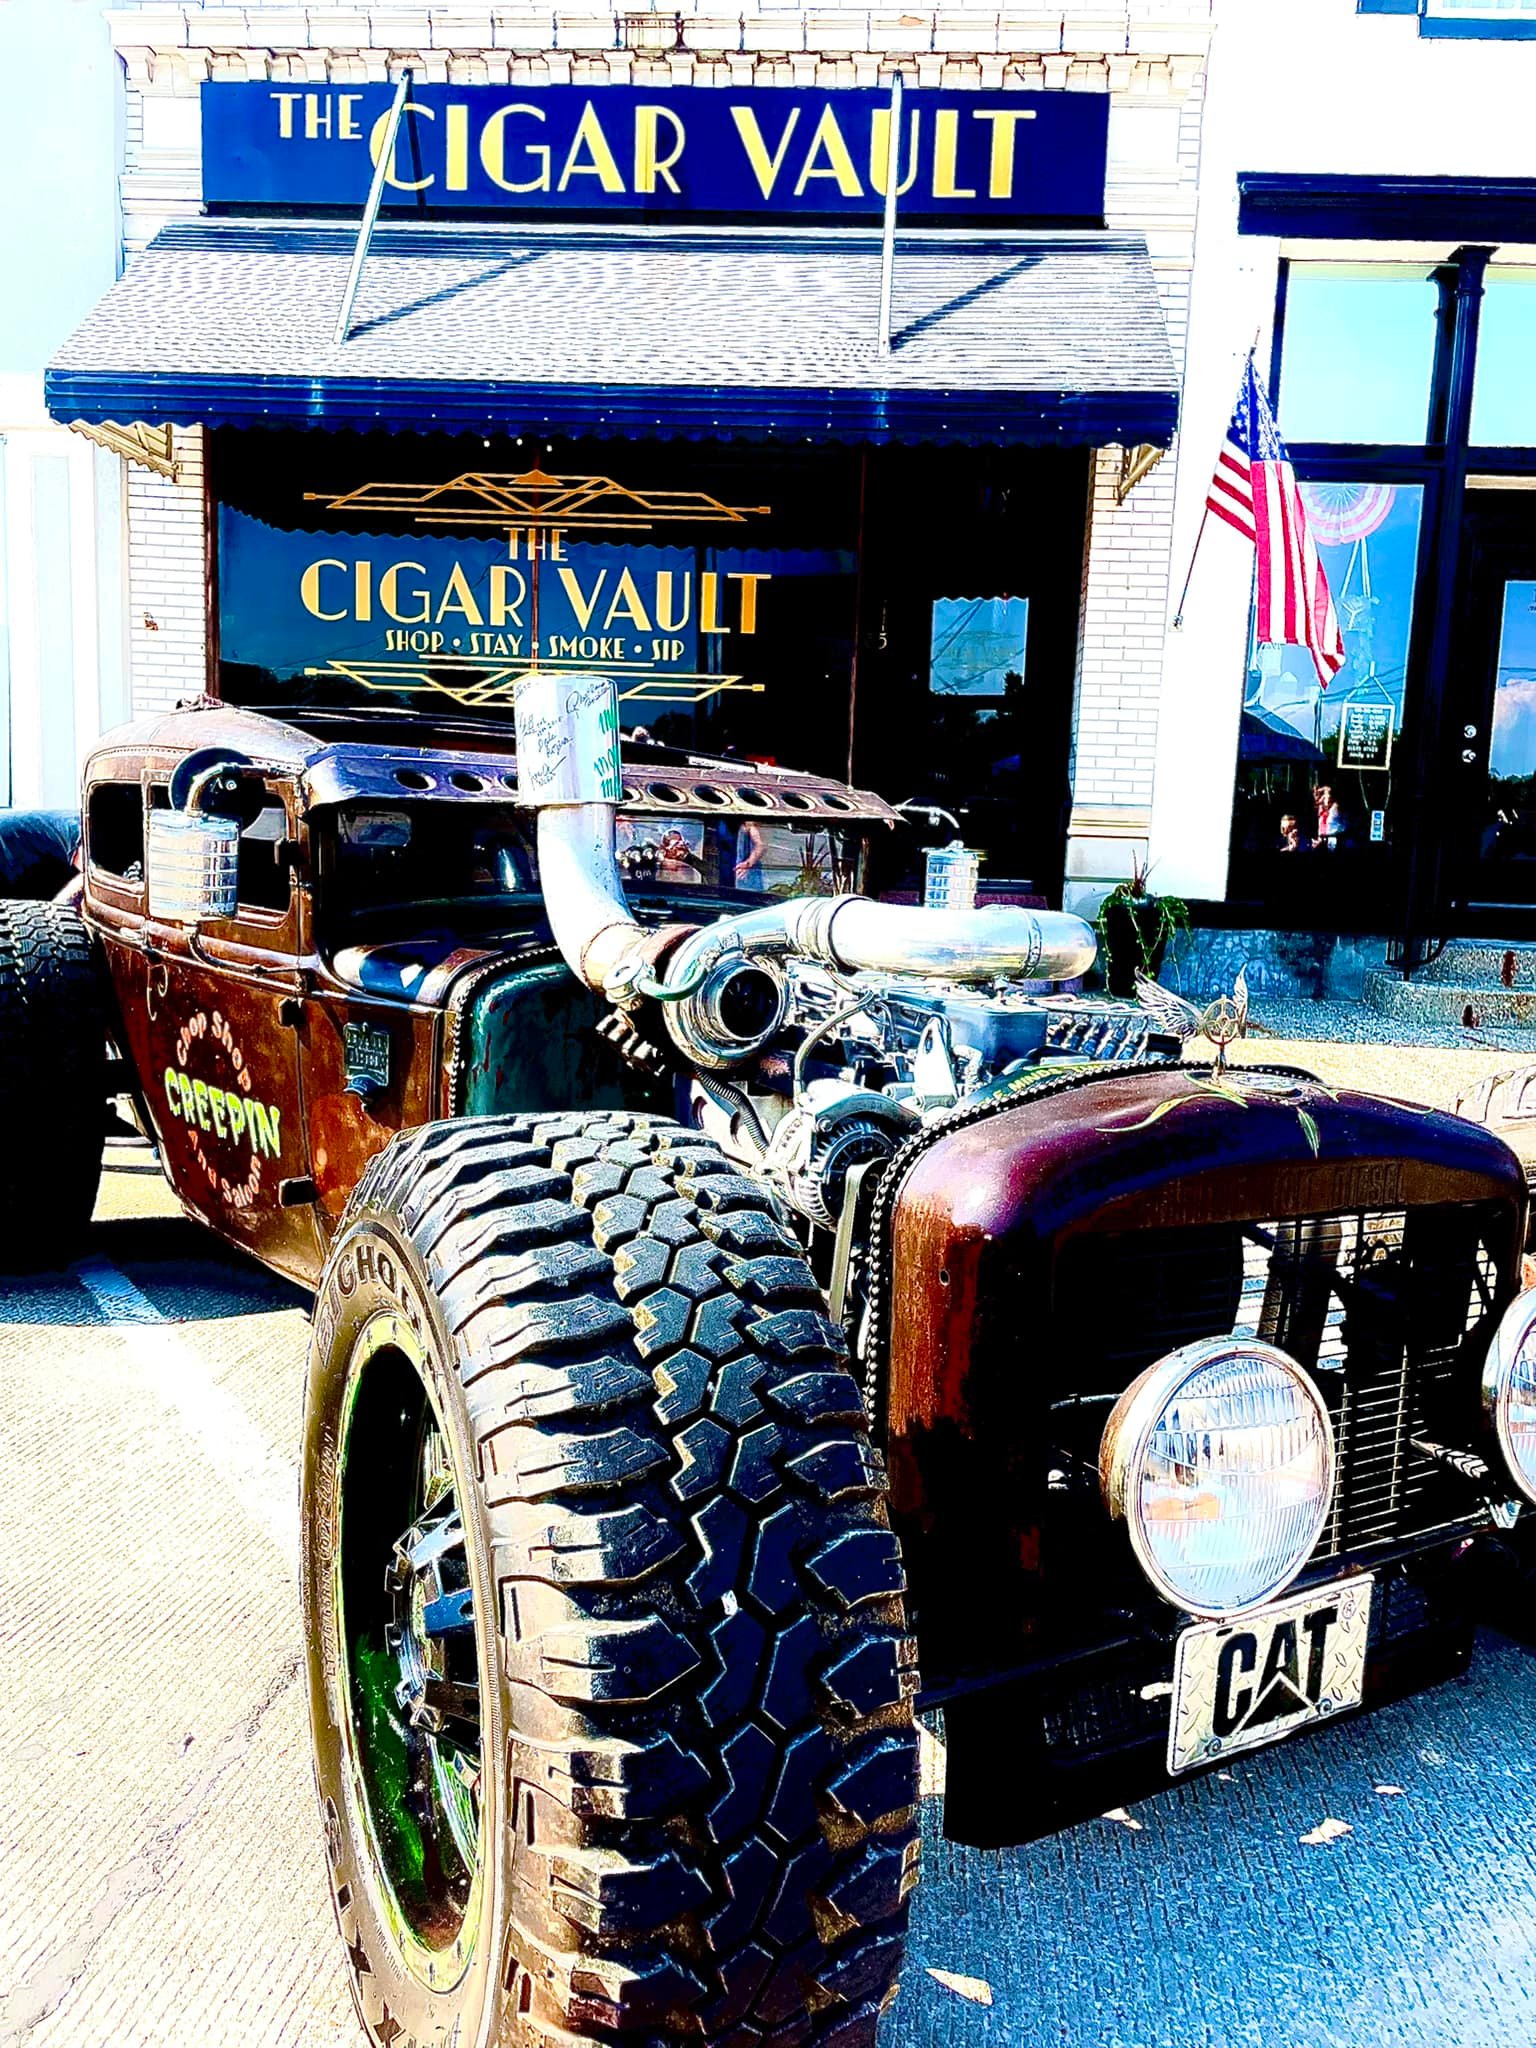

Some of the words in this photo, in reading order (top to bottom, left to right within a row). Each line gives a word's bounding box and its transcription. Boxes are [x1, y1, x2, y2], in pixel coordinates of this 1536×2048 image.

[270, 92, 364, 141] THE
[369, 99, 686, 194] CIGAR
[731, 104, 1037, 200] VAULT
[503, 527, 569, 562] THE
[300, 558, 527, 629] CIGAR
[558, 565, 772, 635] VAULT
[385, 629, 445, 653] SHOP
[470, 632, 524, 656] STAY
[548, 635, 626, 660] SMOKE
[651, 638, 686, 662] SIP
[176, 1012, 207, 1067] Chop
[211, 1010, 252, 1092] Shop
[164, 1066, 282, 1159] CREEPIN
[220, 1153, 262, 1209] Saloon
[1211, 1604, 1339, 1738] CAT
